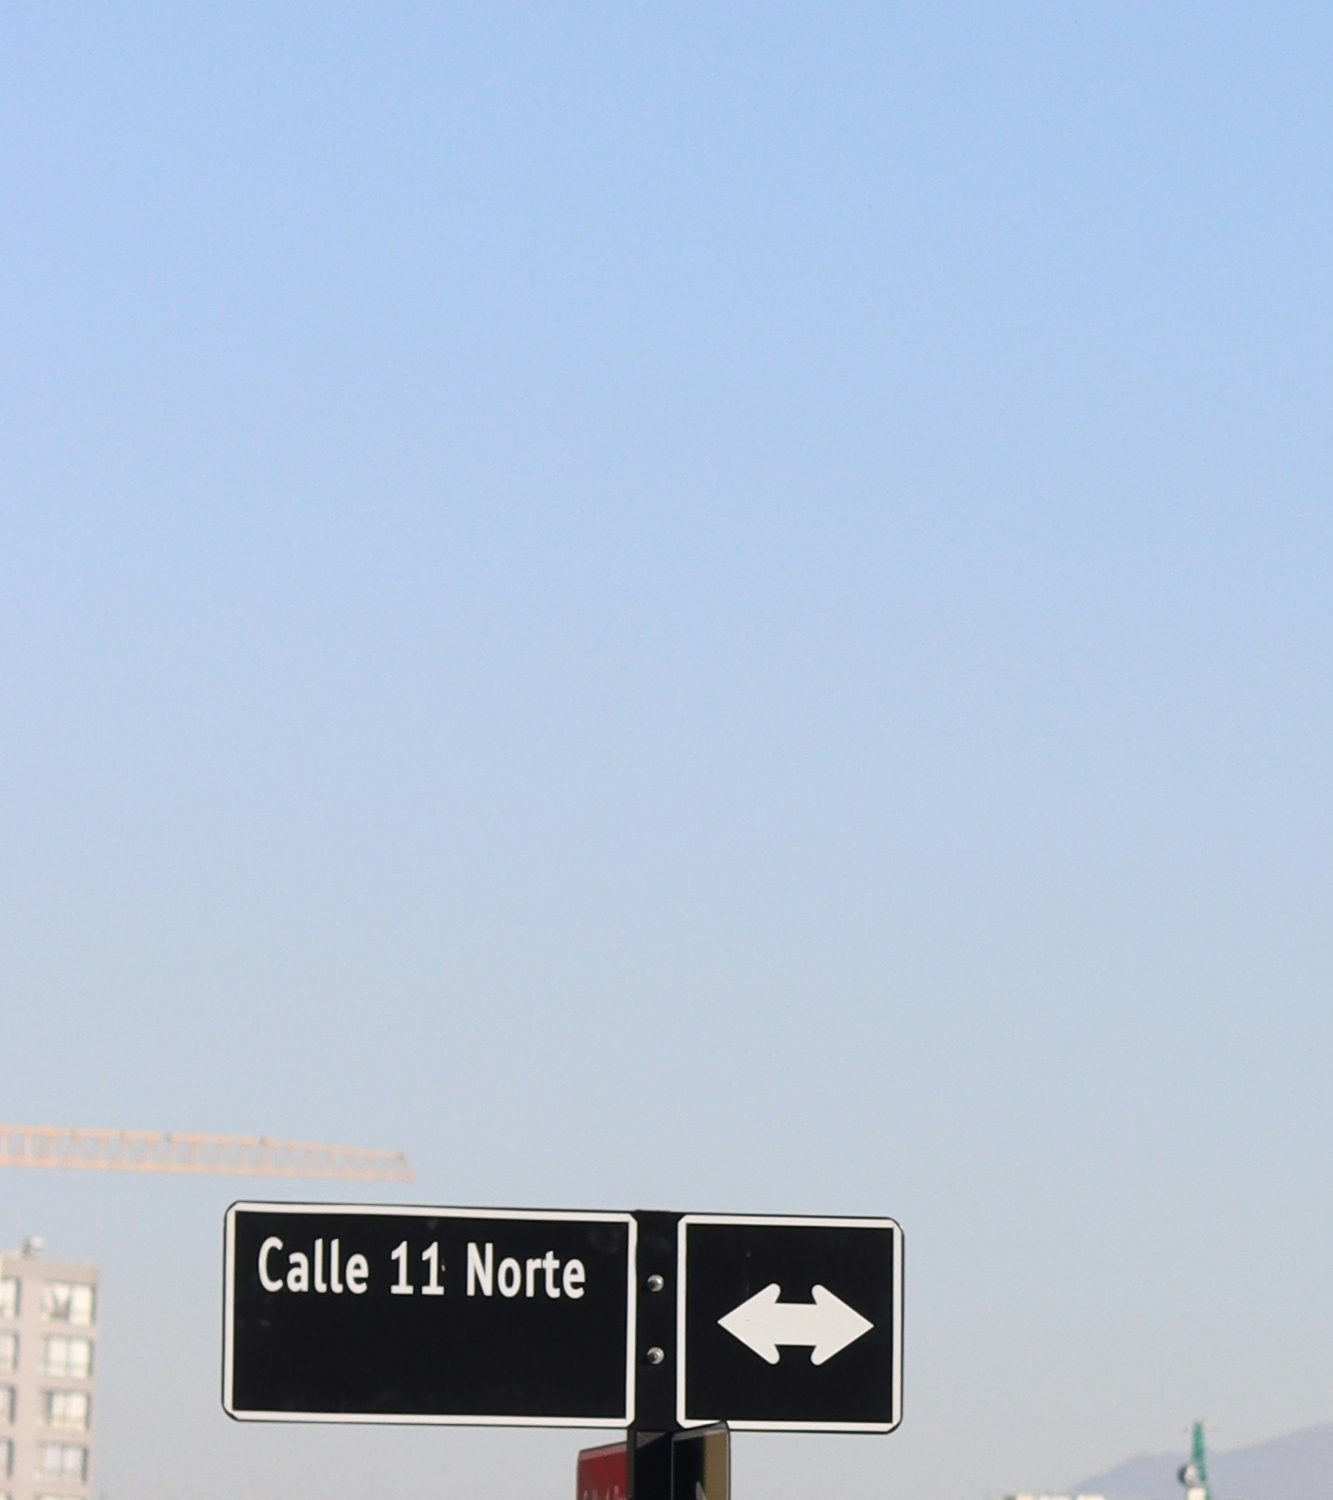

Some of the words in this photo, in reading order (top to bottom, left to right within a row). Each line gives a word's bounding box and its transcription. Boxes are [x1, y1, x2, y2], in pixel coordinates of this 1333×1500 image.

[258, 1236, 369, 1294] Calle
[390, 1240, 445, 1295] 11
[466, 1242, 586, 1299] Norte
